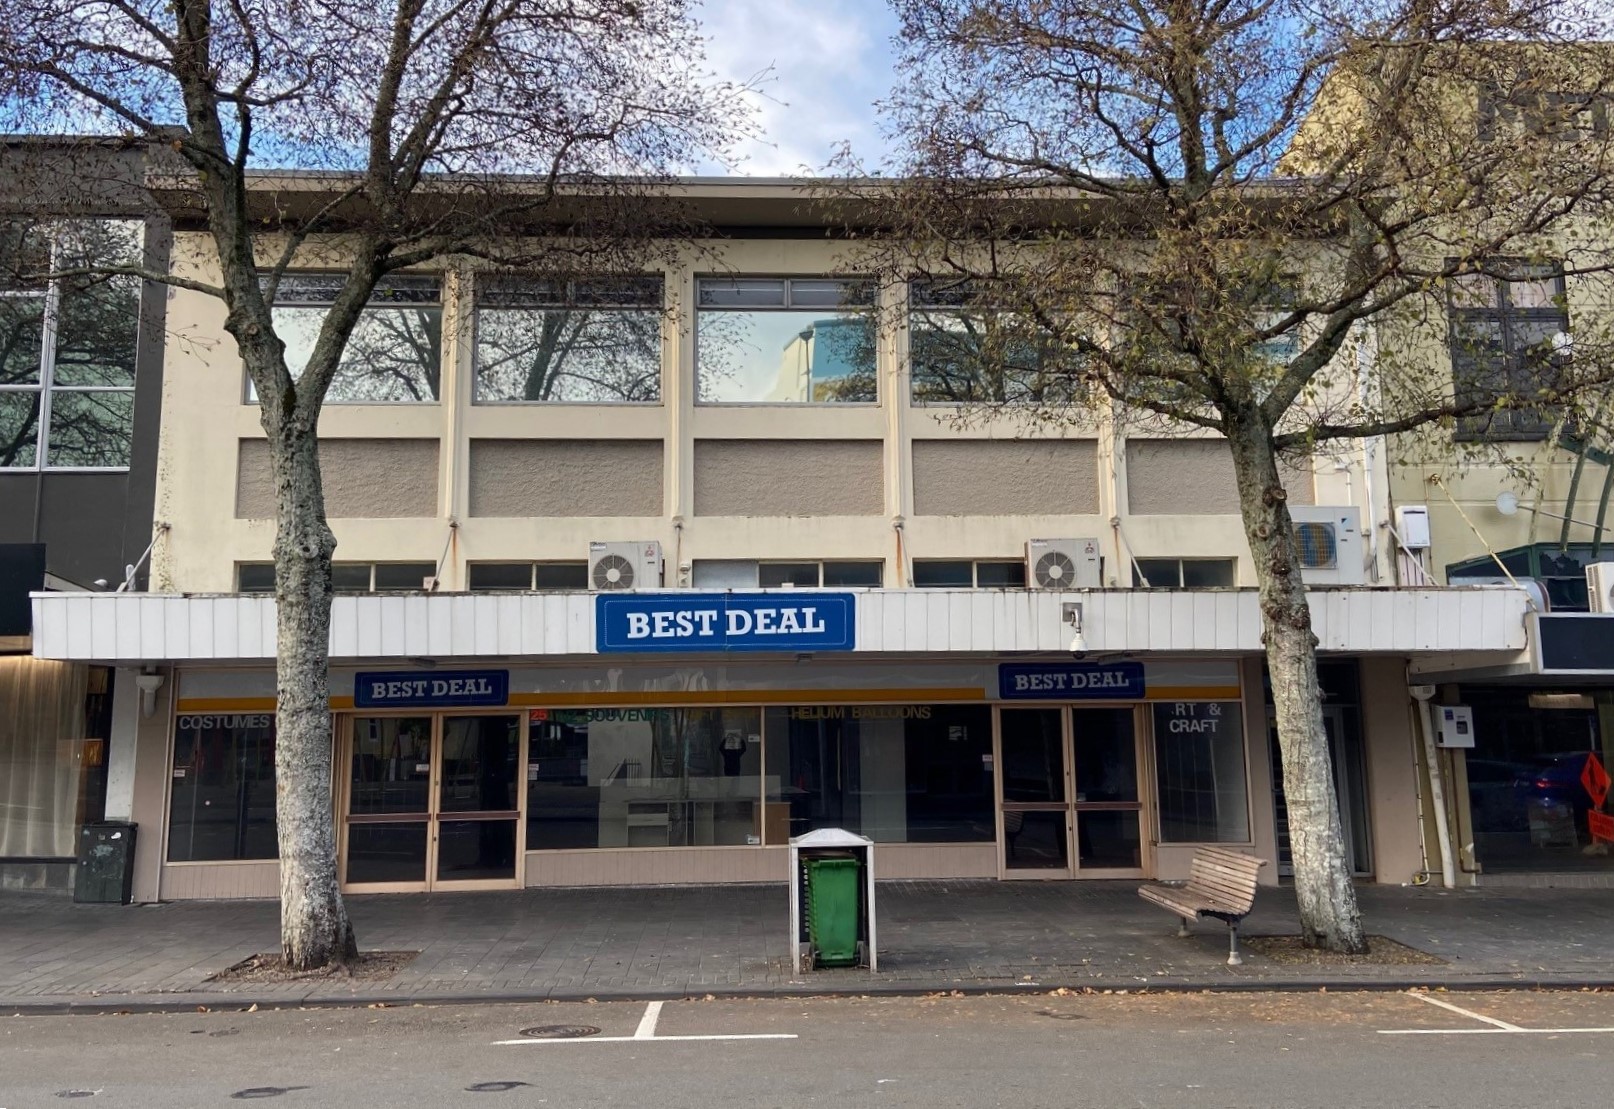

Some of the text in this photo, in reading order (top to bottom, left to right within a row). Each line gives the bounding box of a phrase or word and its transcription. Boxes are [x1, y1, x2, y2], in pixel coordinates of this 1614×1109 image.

[626, 607, 826, 639] BEST DEAL
[371, 678, 493, 699] BEST DEAL
[1015, 671, 1129, 691] BEST DEAL
[790, 705, 932, 720] HELIUM BALLOONS
[1171, 703, 1222, 716] RT &
[179, 715, 271, 730] COSTUMES
[1169, 719, 1219, 733] CRAFT
